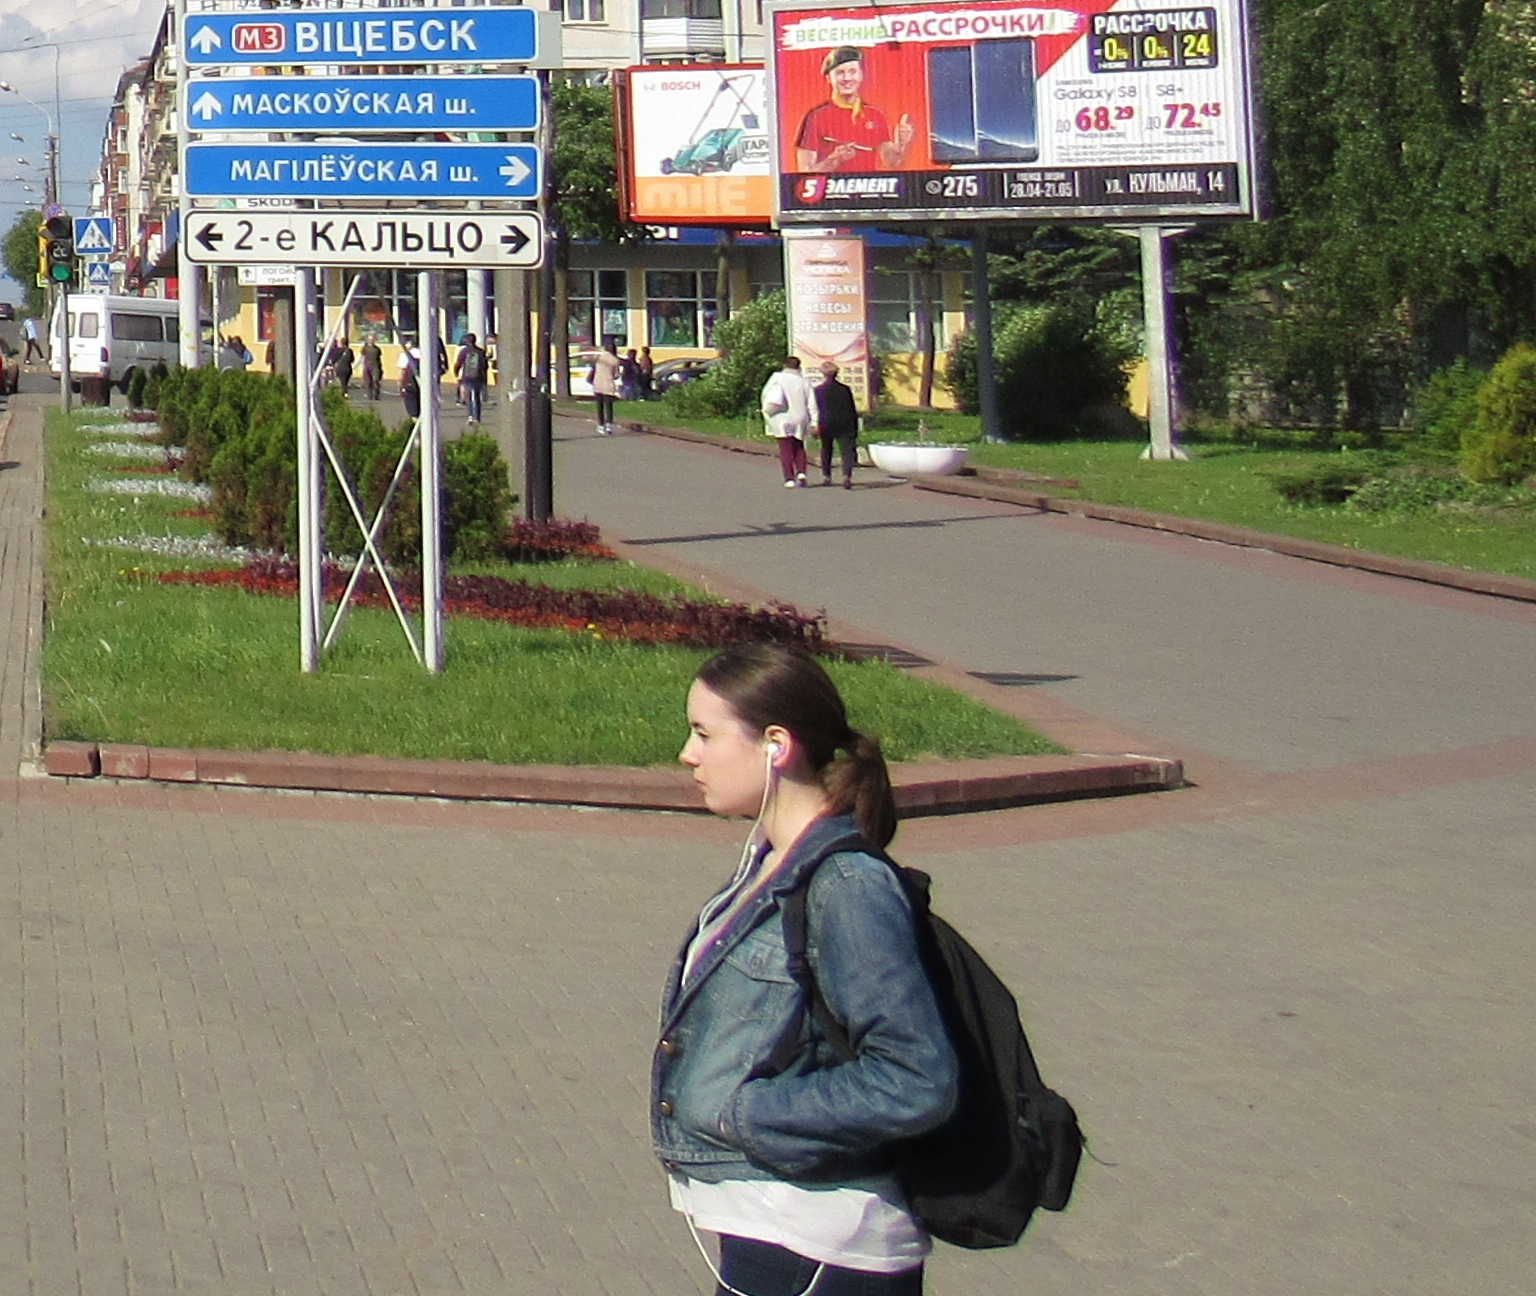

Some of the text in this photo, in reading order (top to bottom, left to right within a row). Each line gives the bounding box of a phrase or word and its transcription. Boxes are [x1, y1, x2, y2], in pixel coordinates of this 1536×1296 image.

[1094, 10, 1209, 35] РАССРОЧКА
[296, 18, 477, 58] ВІЦЕБСК
[1182, 33, 1211, 58] 24
[660, 81, 702, 91] BOSCH
[1054, 86, 1115, 102] Galaxy
[1117, 85, 1138, 98] S8
[232, 89, 476, 115] МАСКОЎСКАЯ ш.
[231, 154, 479, 183] МАГІЛЁЎСКАЯ ш.
[824, 177, 899, 194] ЭЛЕМЕНТ
[942, 175, 978, 197] 275
[1128, 172, 1203, 195] КУЛЬМАН,
[1207, 170, 1226, 192] 14
[310, 220, 484, 258] КАЛЬЦО
[806, 302, 852, 314] НАВЕСЫ
[795, 321, 865, 333] ОГРАЖДЕНИЯ
